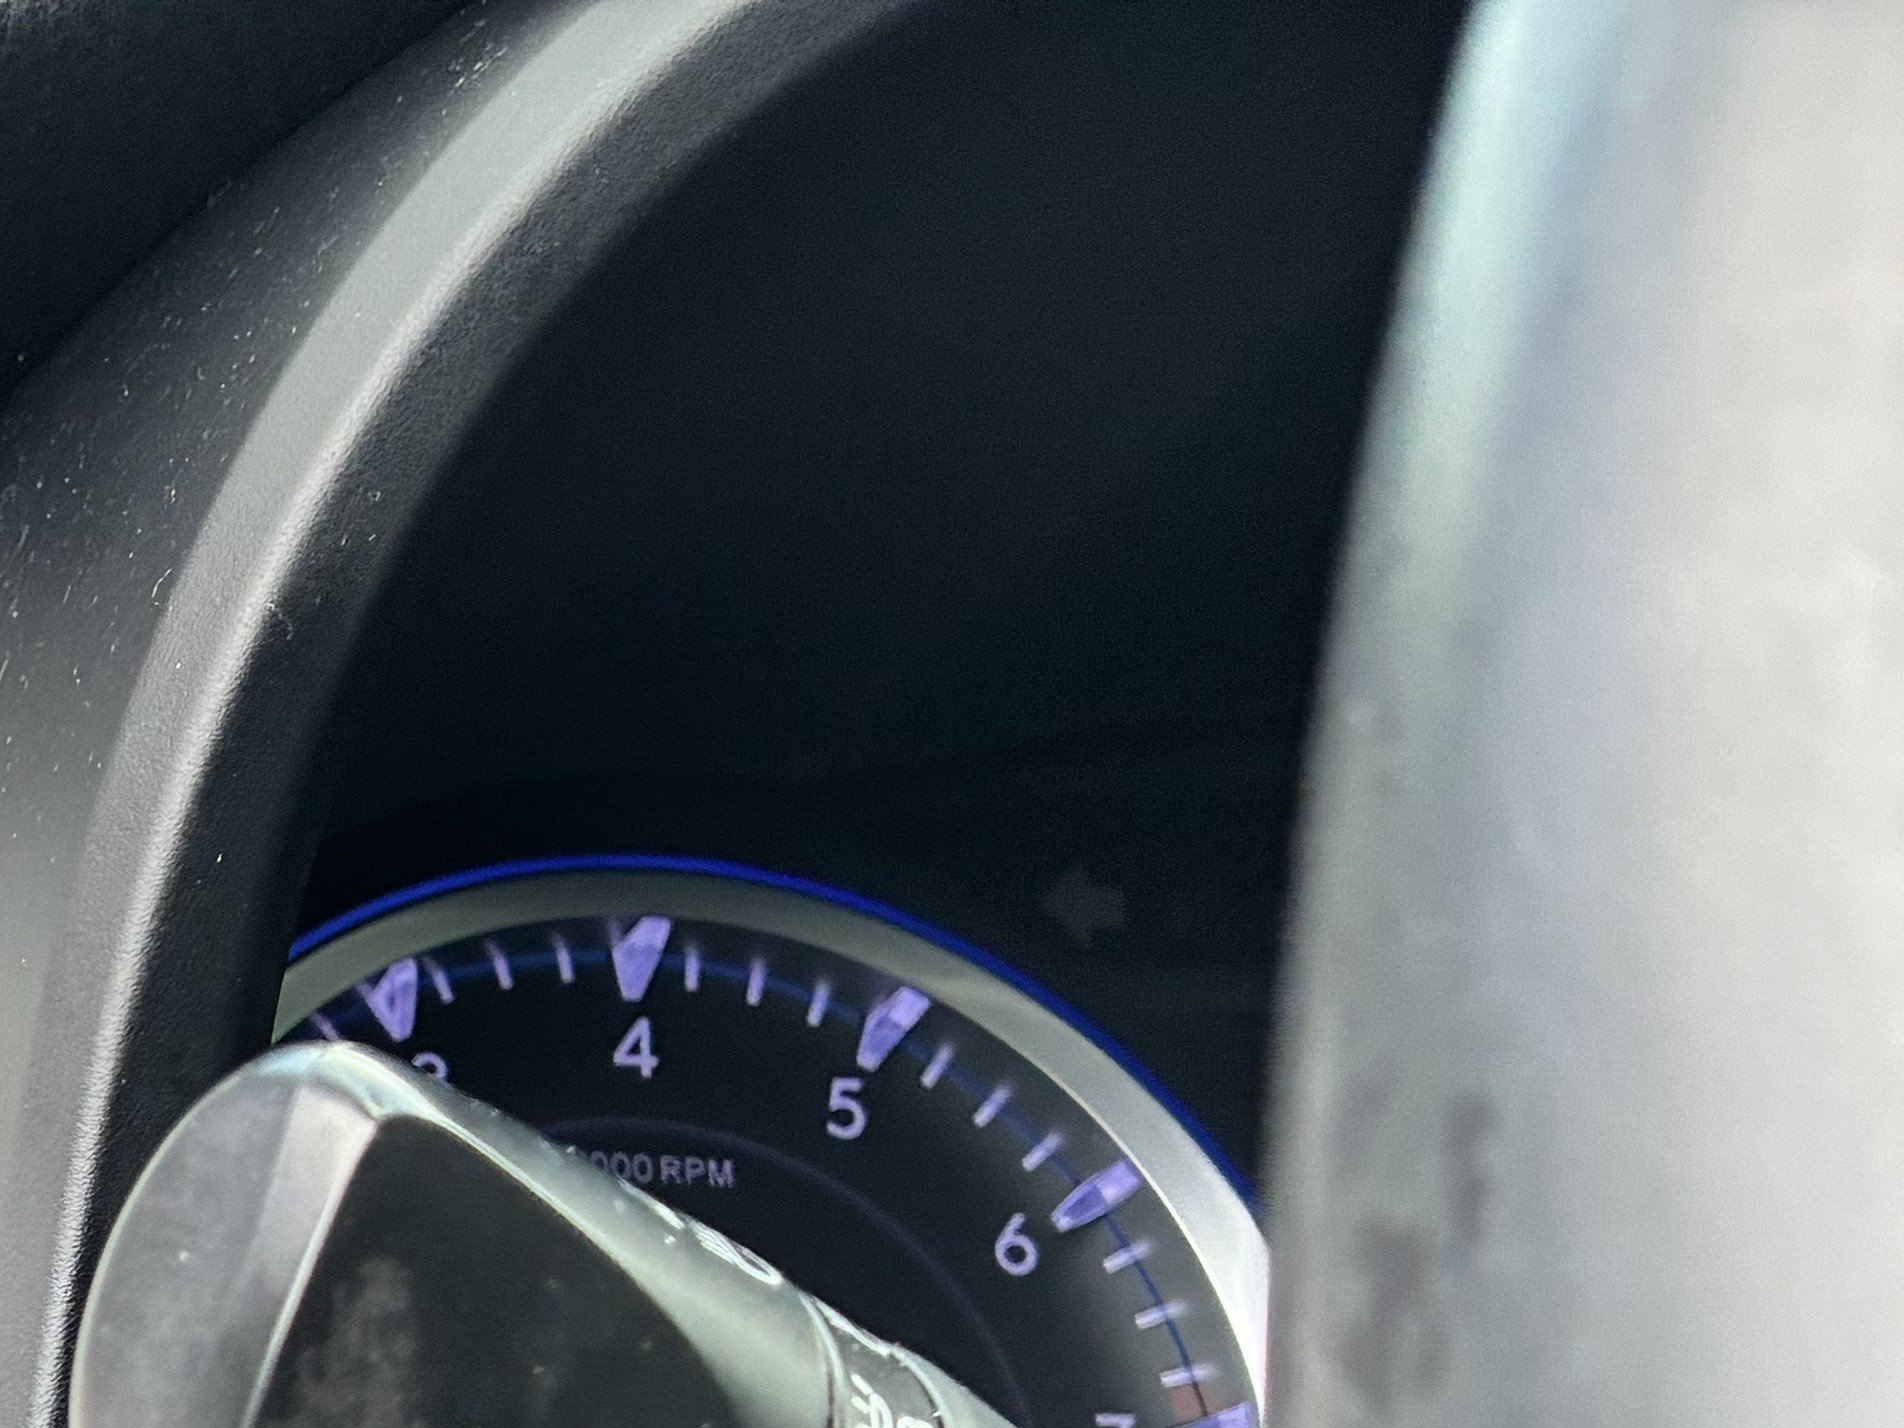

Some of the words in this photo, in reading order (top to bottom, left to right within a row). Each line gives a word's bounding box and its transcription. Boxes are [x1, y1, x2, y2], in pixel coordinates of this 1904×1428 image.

[612, 1016, 659, 1079] 4
[826, 1078, 867, 1141] 5
[660, 1154, 735, 1188] RPM
[995, 1213, 1040, 1276] 6
